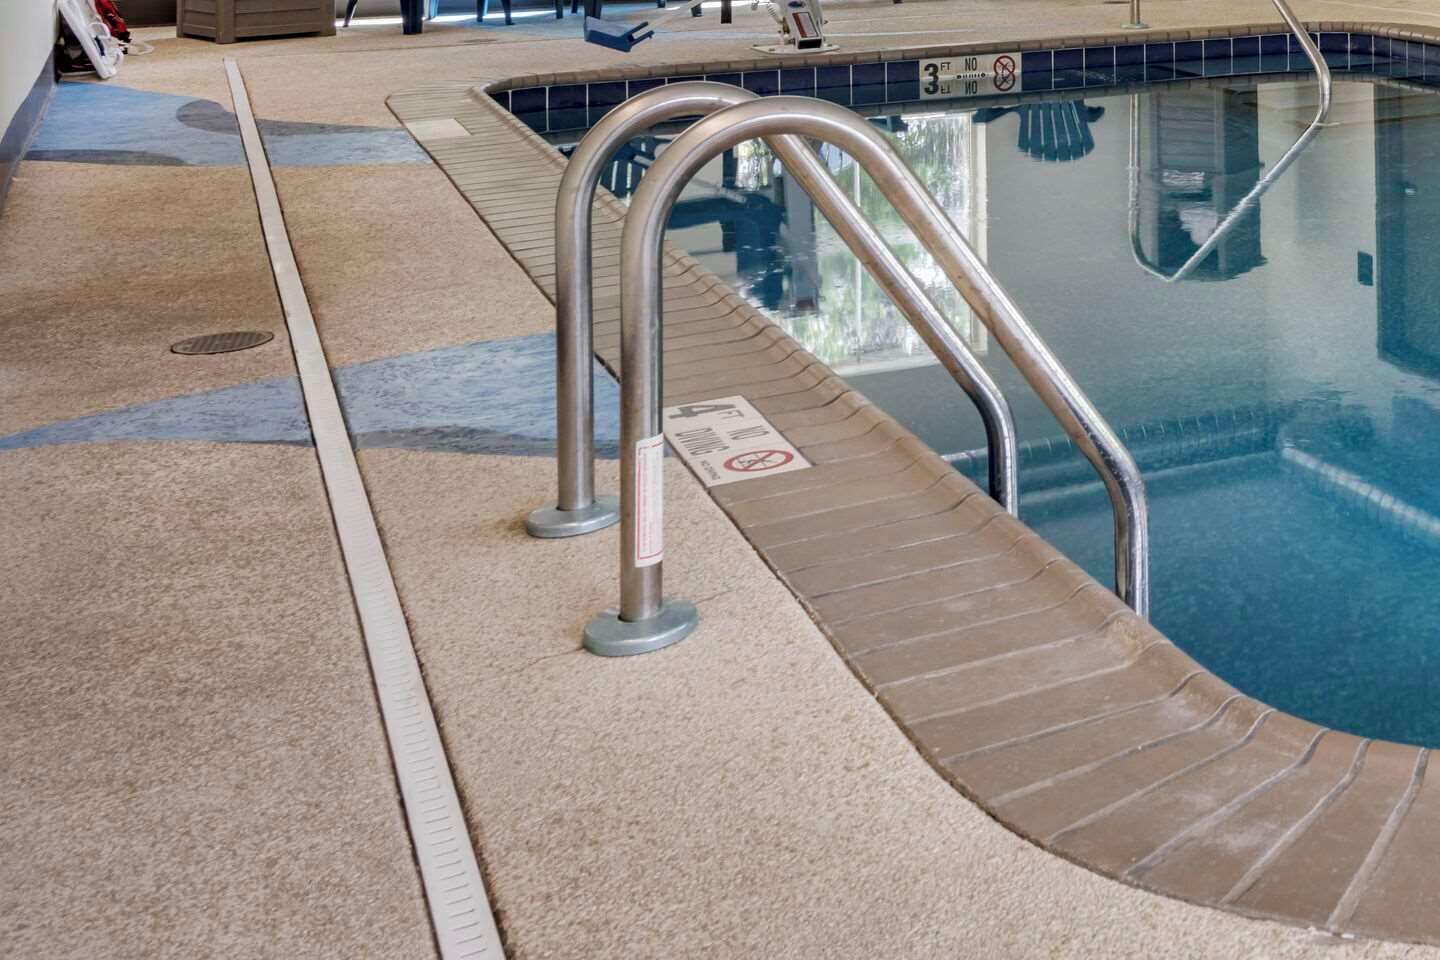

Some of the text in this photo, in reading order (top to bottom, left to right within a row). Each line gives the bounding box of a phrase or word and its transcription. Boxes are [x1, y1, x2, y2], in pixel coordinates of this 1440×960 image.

[924, 62, 951, 80] 3 FT
[965, 57, 977, 71] NO
[668, 404, 744, 419] 4 FT
[727, 425, 770, 440] NO
[675, 427, 730, 456] DIVING
